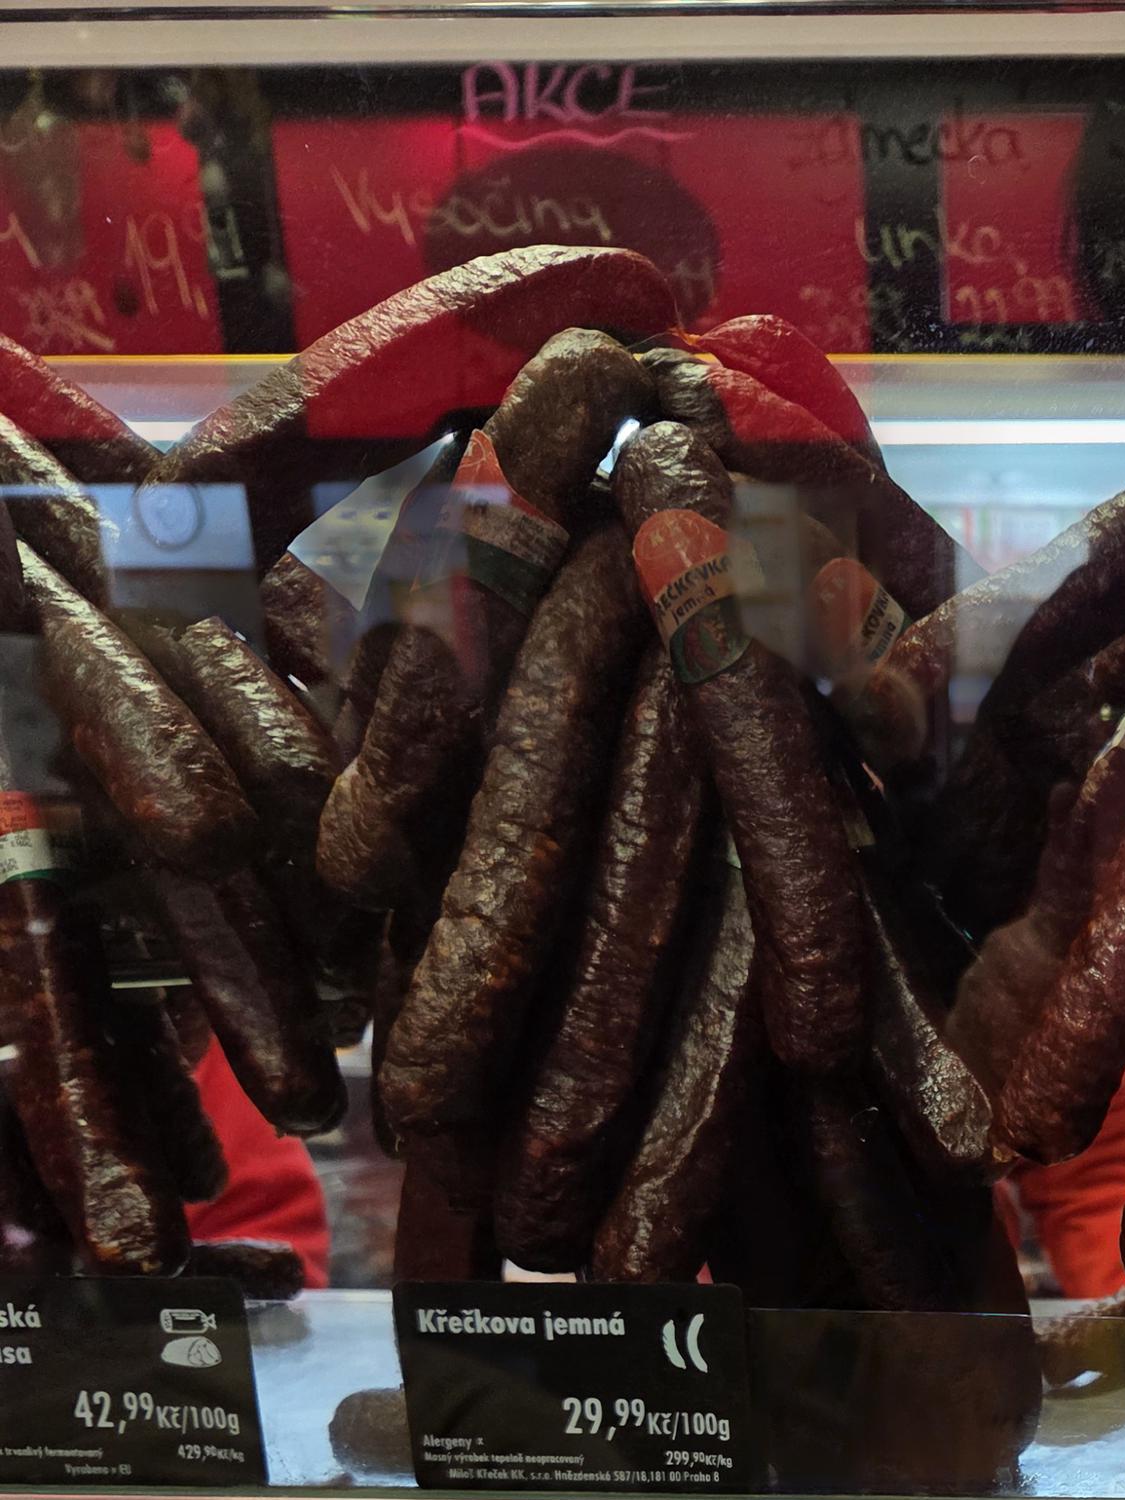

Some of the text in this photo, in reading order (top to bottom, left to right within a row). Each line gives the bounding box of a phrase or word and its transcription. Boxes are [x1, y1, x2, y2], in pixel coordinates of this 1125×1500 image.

[461, 63, 671, 123] AKCE
[417, 1309, 625, 1340] Křečkova jemná
[0, 1345, 32, 1365] sa
[423, 1434, 472, 1450] Alergeny
[424, 1452, 452, 1464] Masný
[454, 1452, 490, 1464] výrobek
[526, 1454, 585, 1467] neopracovaný
[669, 1471, 682, 1482] 00
[684, 1471, 711, 1483] Praha
[713, 1471, 720, 1483] 8
